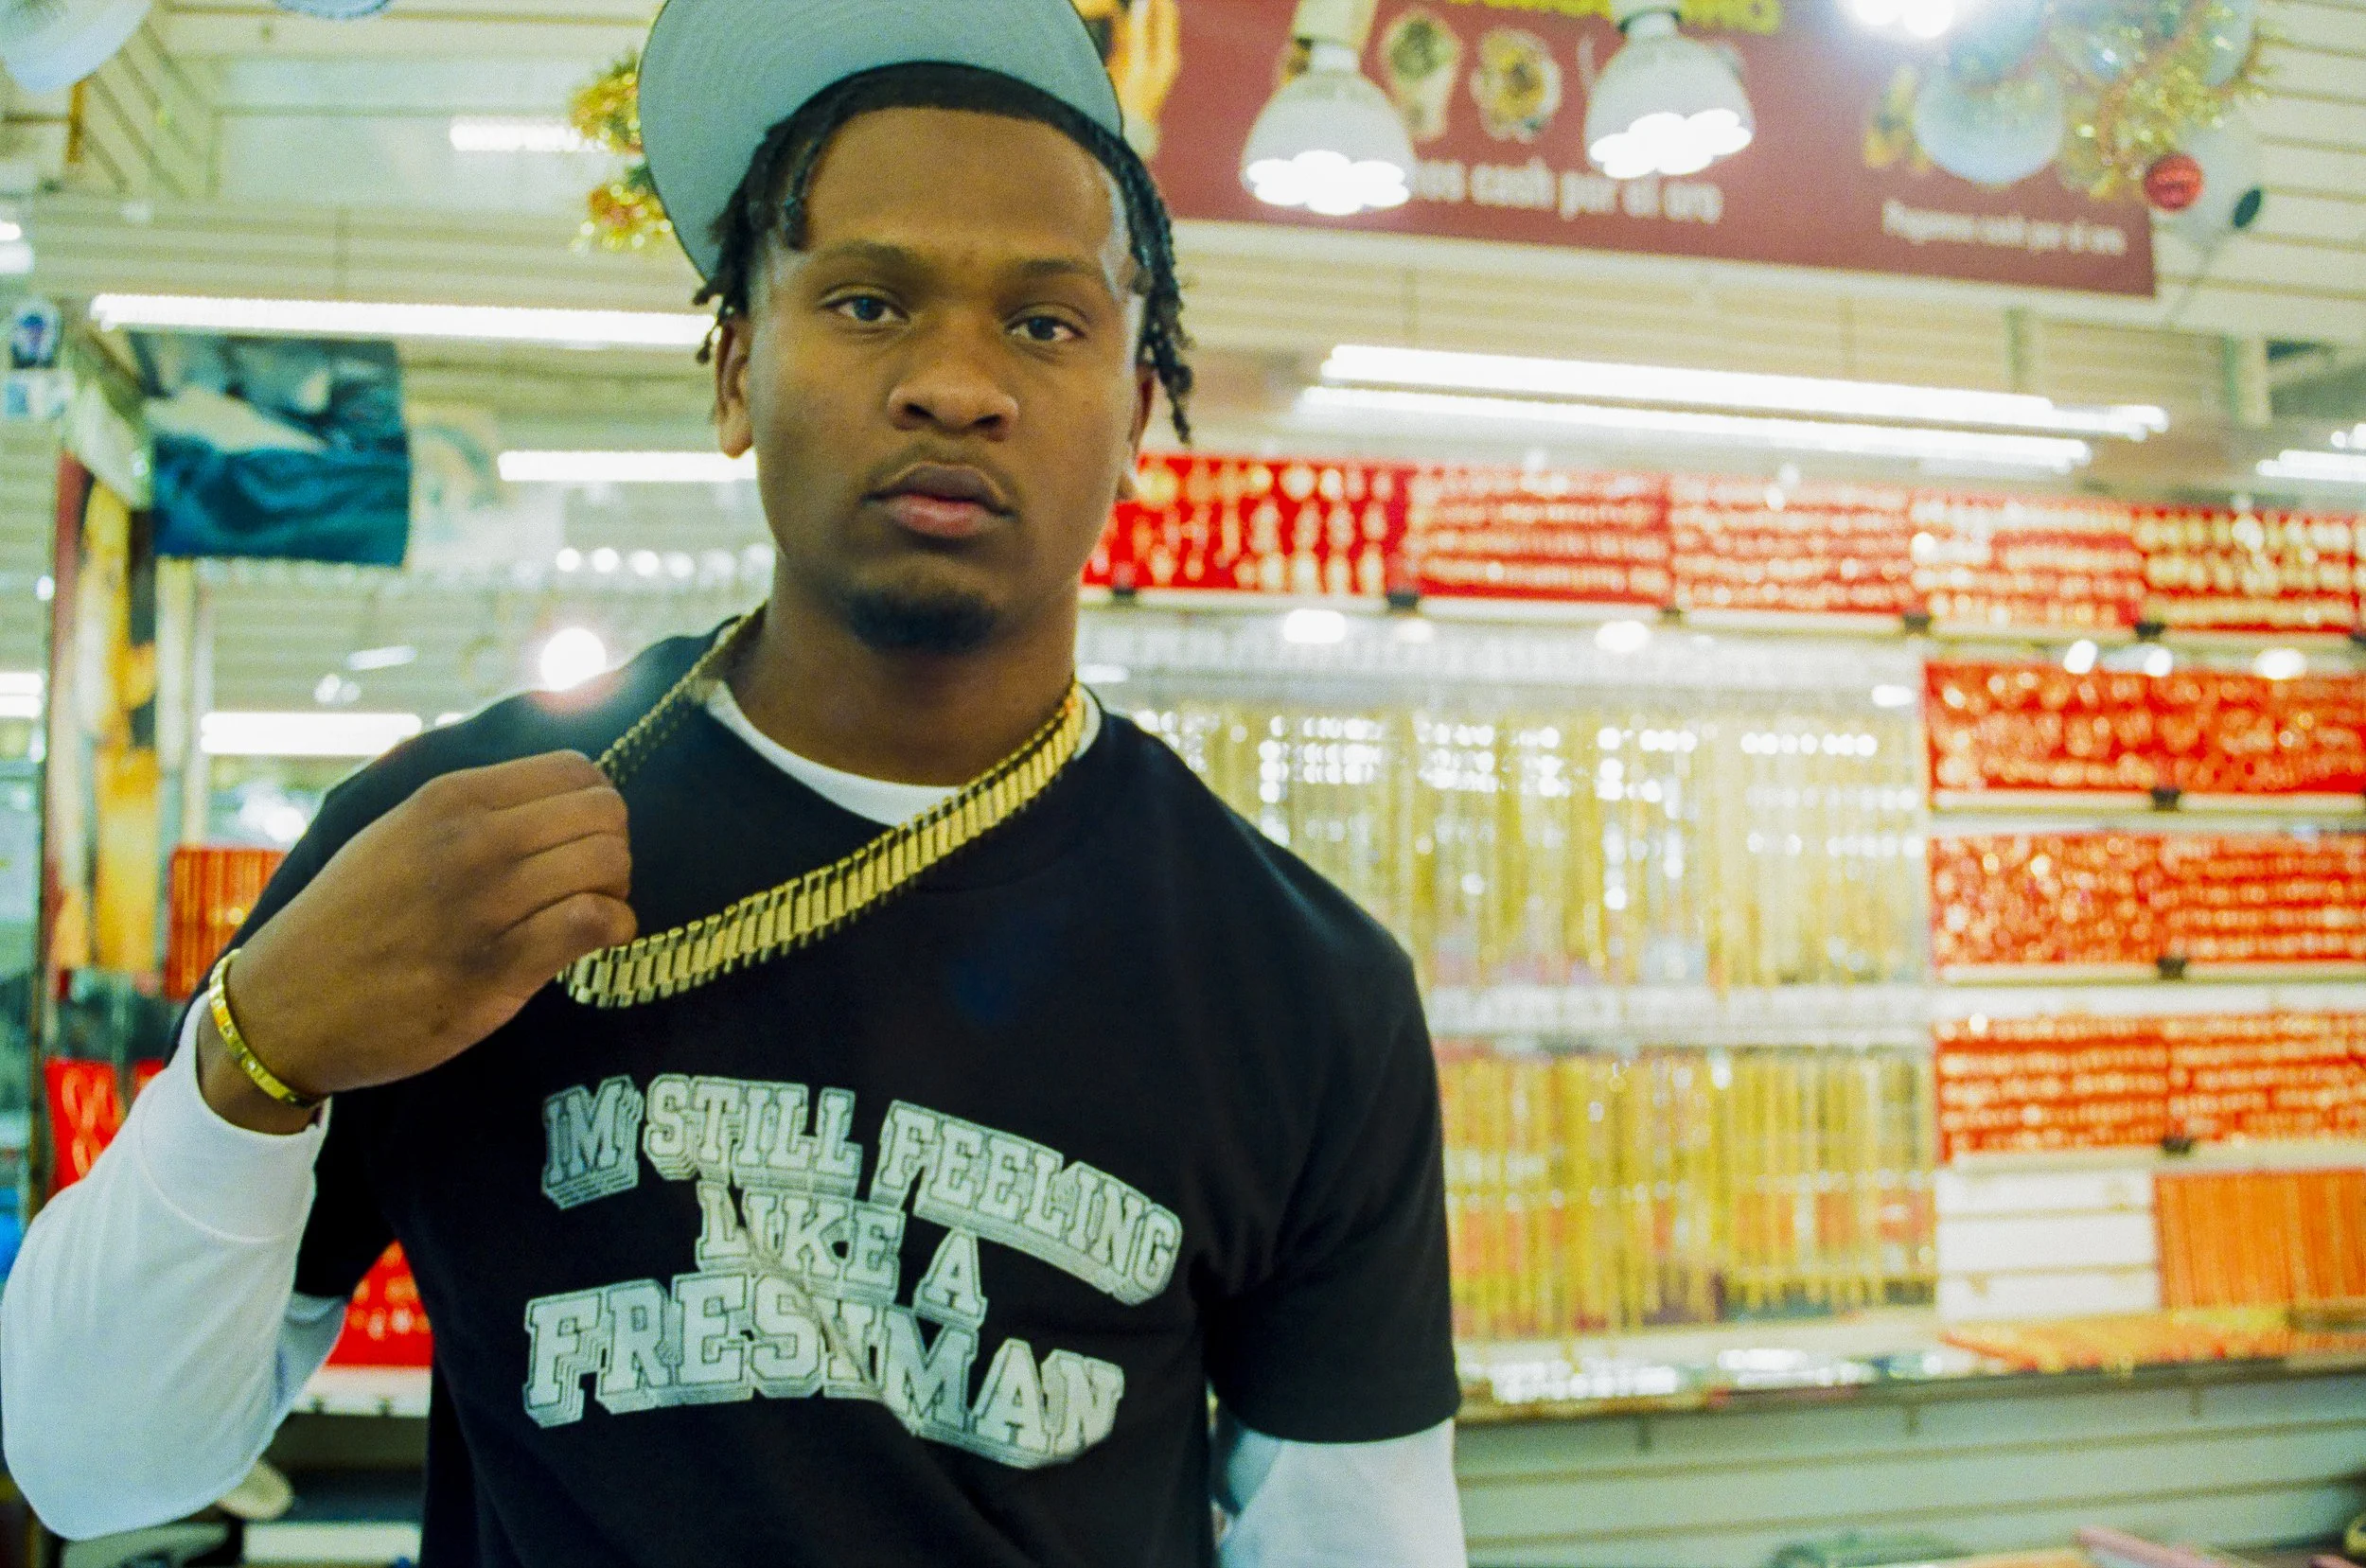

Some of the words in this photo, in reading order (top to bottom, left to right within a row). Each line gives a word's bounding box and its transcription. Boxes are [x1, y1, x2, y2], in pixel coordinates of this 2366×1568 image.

[644, 1074, 862, 1195] STILL
[870, 1100, 1182, 1306] FEELING
[696, 1180, 906, 1304] LIKE
[913, 1228, 987, 1328] A
[524, 1271, 1125, 1470] FRESHMAN
